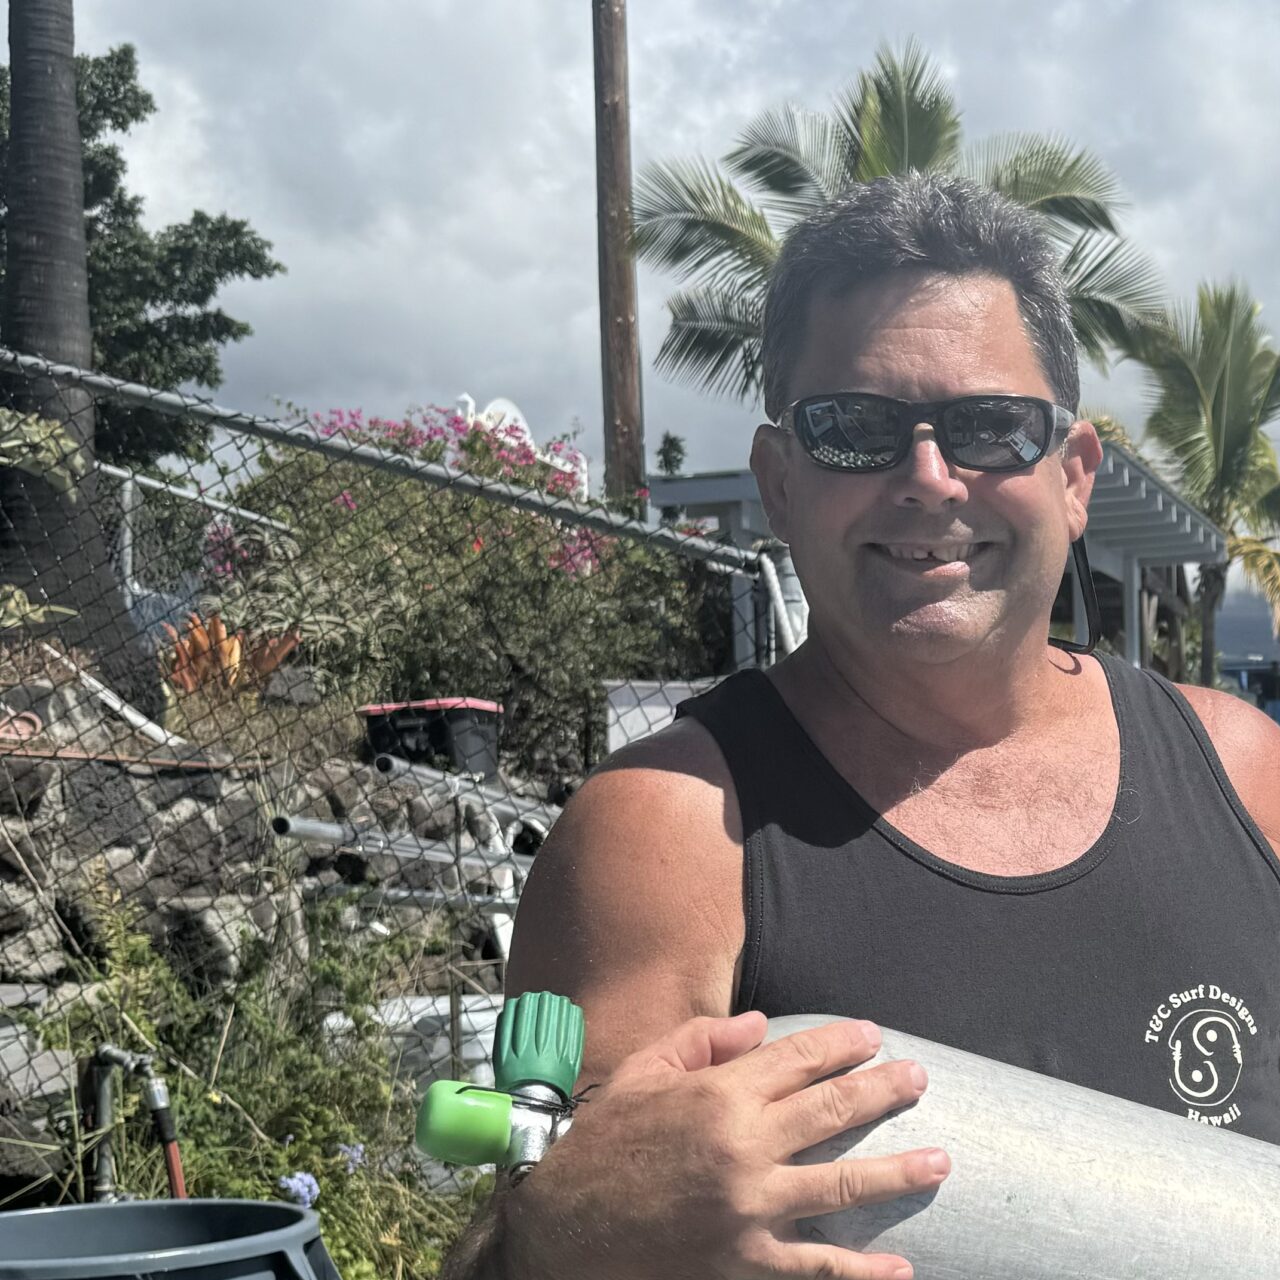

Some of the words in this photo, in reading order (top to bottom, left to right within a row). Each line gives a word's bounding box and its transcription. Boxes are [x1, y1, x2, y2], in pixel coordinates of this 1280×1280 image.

[1145, 1004, 1171, 1043] T&C
[1169, 984, 1205, 1008] Surf
[1209, 985, 1257, 1035] Designs
[1188, 1103, 1241, 1126] Hawaii
